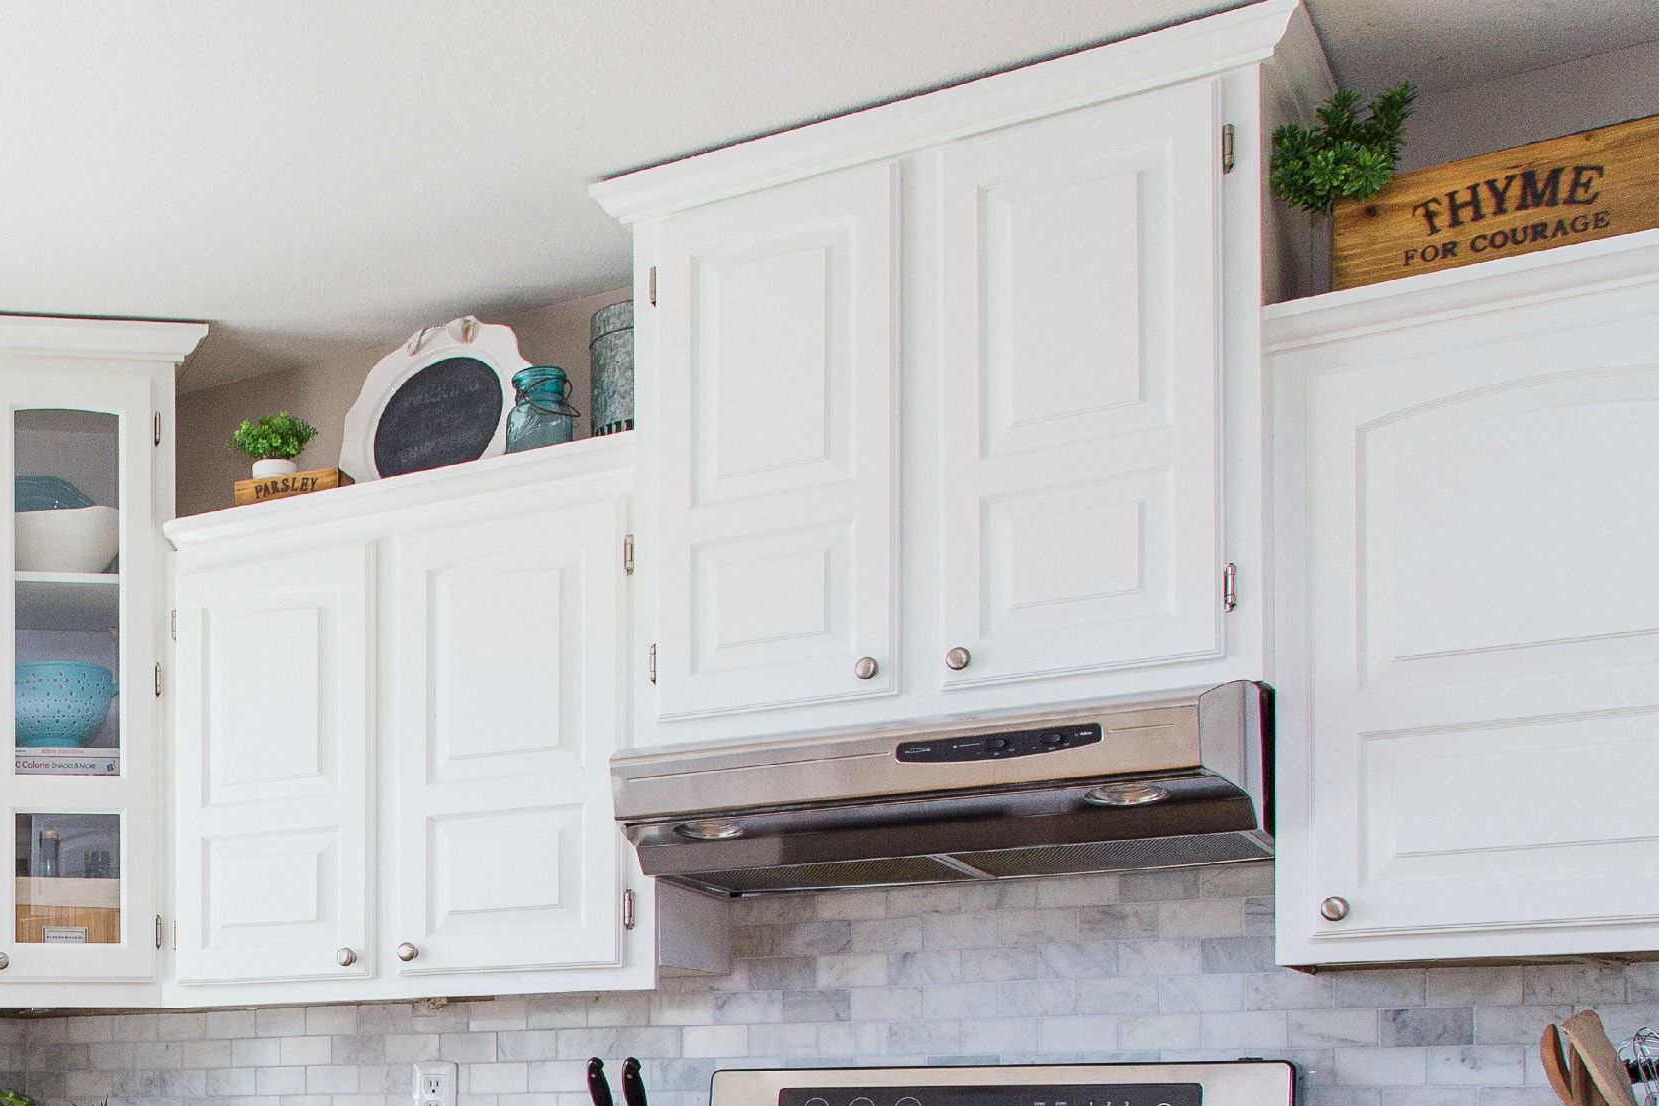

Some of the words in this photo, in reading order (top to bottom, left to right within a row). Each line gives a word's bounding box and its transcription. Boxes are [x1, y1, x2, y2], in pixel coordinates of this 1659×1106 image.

[1412, 165, 1605, 236] THYME
[1403, 239, 1458, 267] FOR
[1469, 209, 1611, 254] COURAGE
[254, 477, 319, 499] PARSLEY
[21, 759, 50, 770] Calorie
